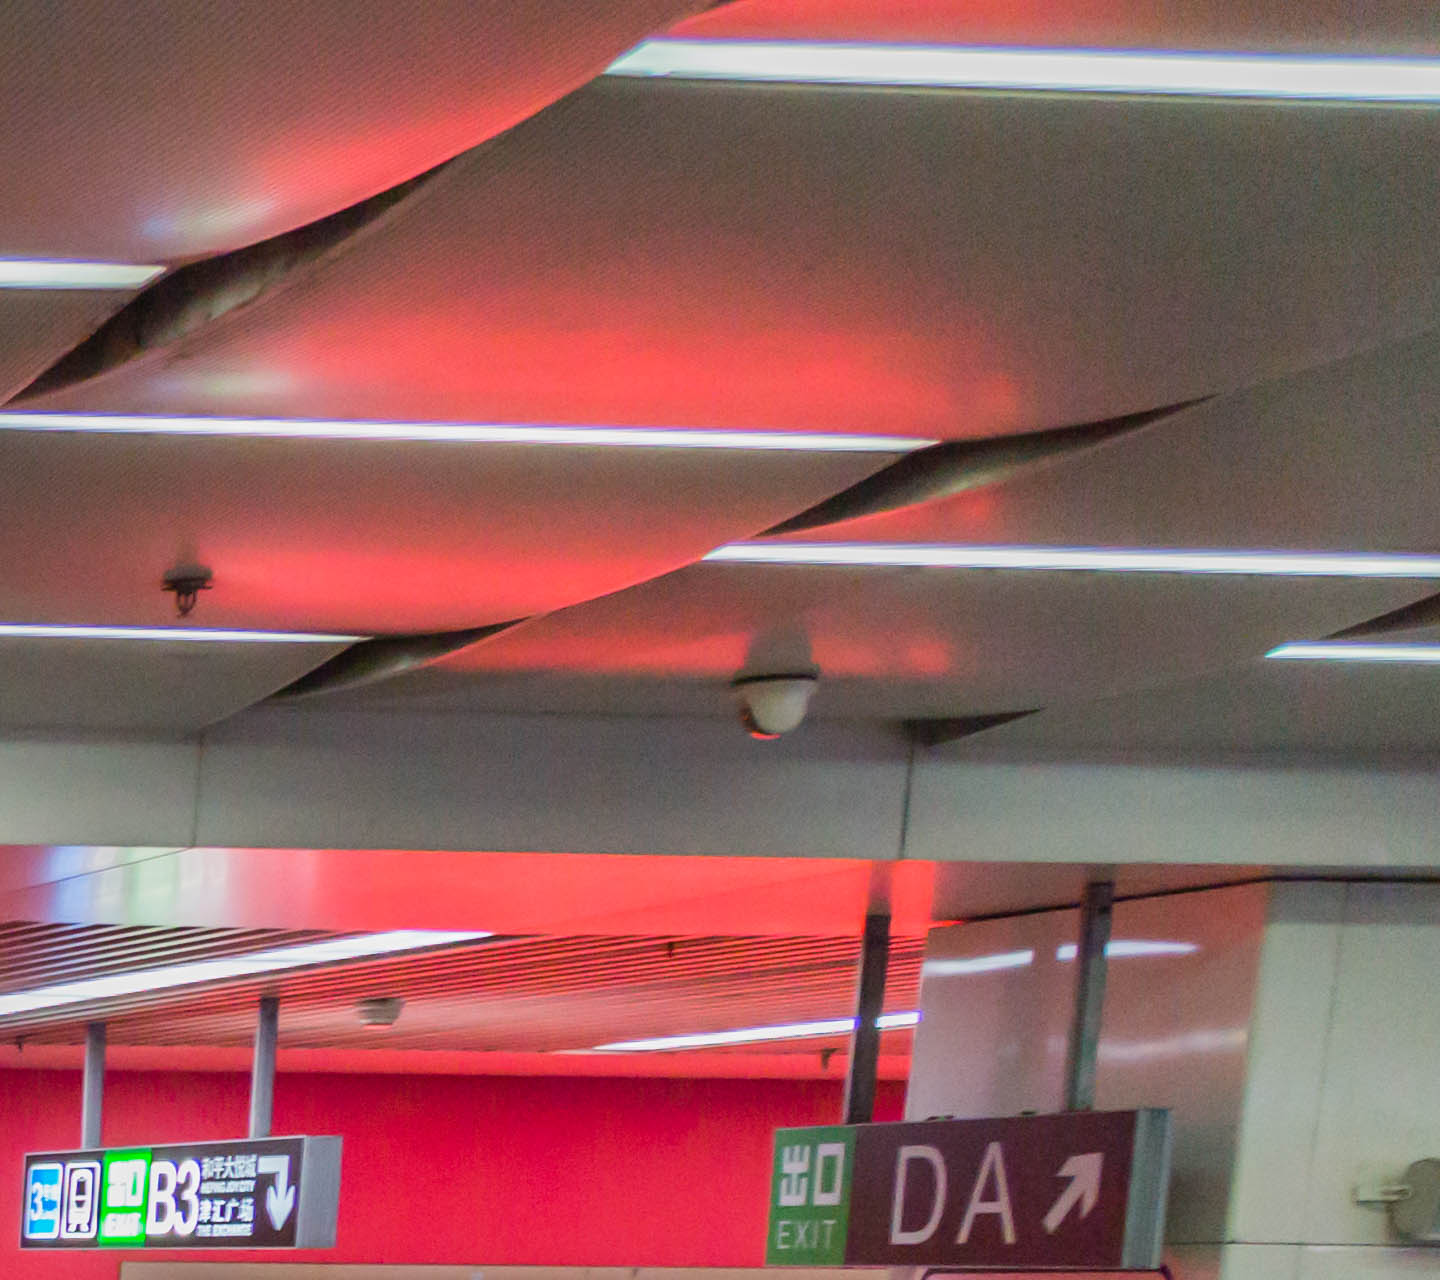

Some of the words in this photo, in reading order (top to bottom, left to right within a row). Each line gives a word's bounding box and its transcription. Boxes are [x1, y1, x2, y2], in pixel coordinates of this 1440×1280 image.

[145, 1159, 201, 1237] B3
[779, 1142, 846, 1207] 出口
[777, 1221, 835, 1250] EXIT
